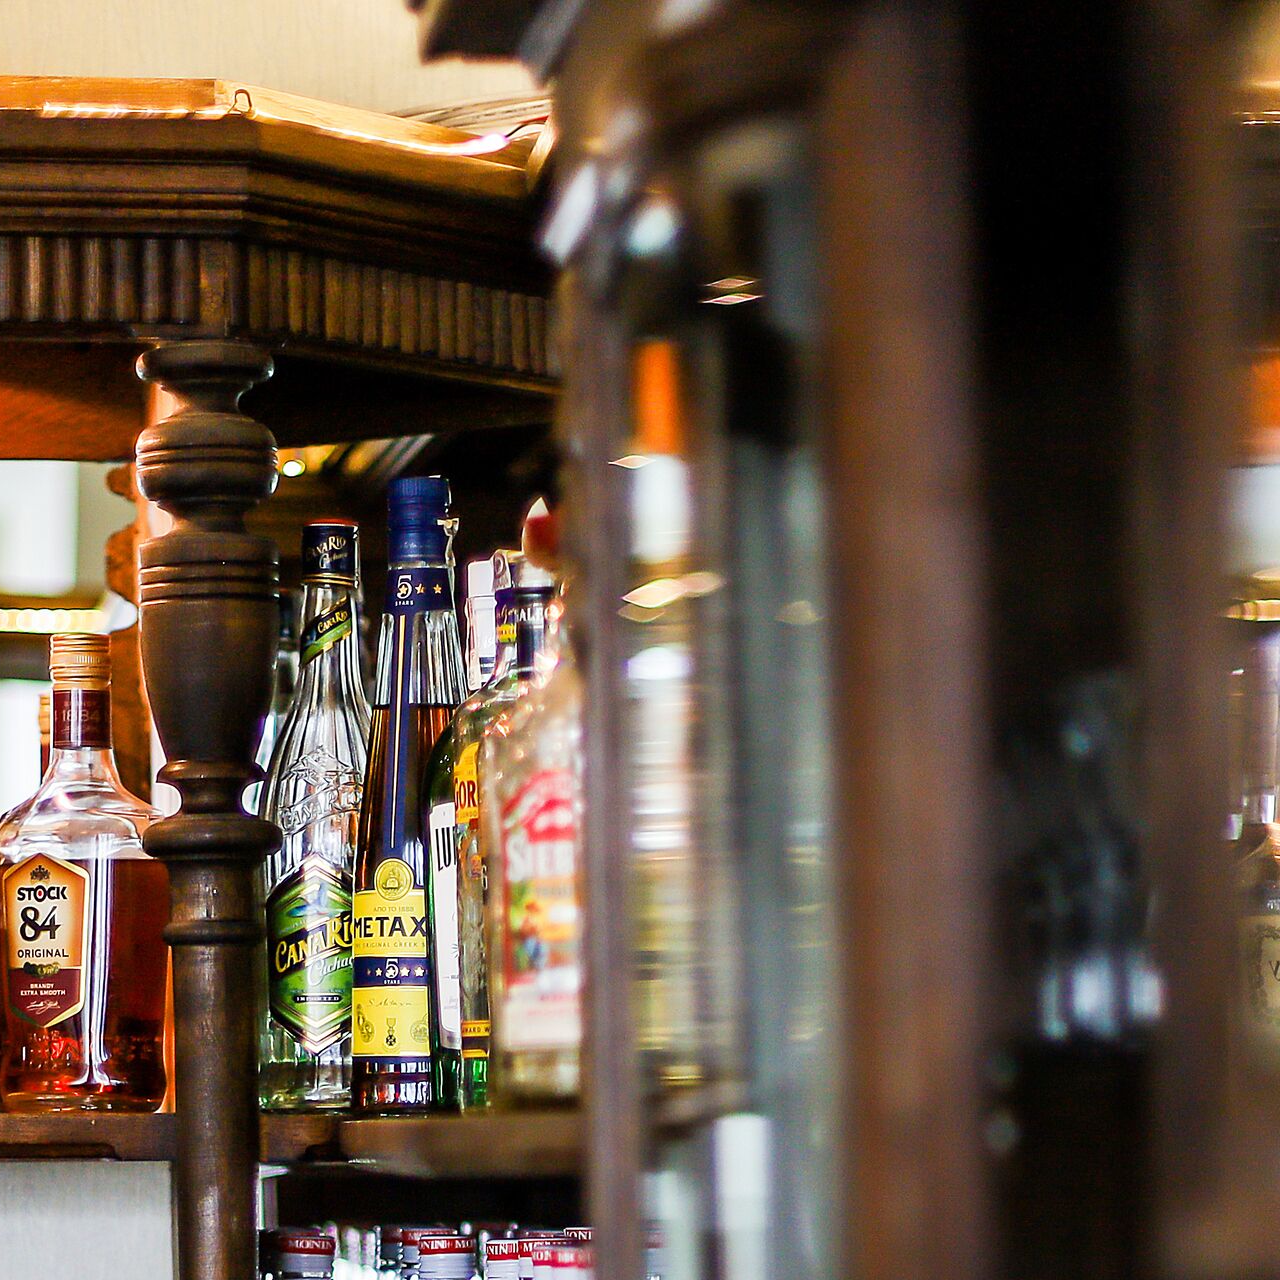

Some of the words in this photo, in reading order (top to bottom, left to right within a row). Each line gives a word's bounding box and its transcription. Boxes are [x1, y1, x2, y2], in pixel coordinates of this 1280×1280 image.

[396, 574, 413, 600] 5
[455, 778, 478, 812] GOR
[434, 825, 457, 872] LU
[17, 884, 68, 902] STOCK
[20, 905, 62, 942] 84
[353, 916, 427, 938] METAX
[17, 948, 70, 959] ORIGINAL
[385, 958, 399, 979] 5
